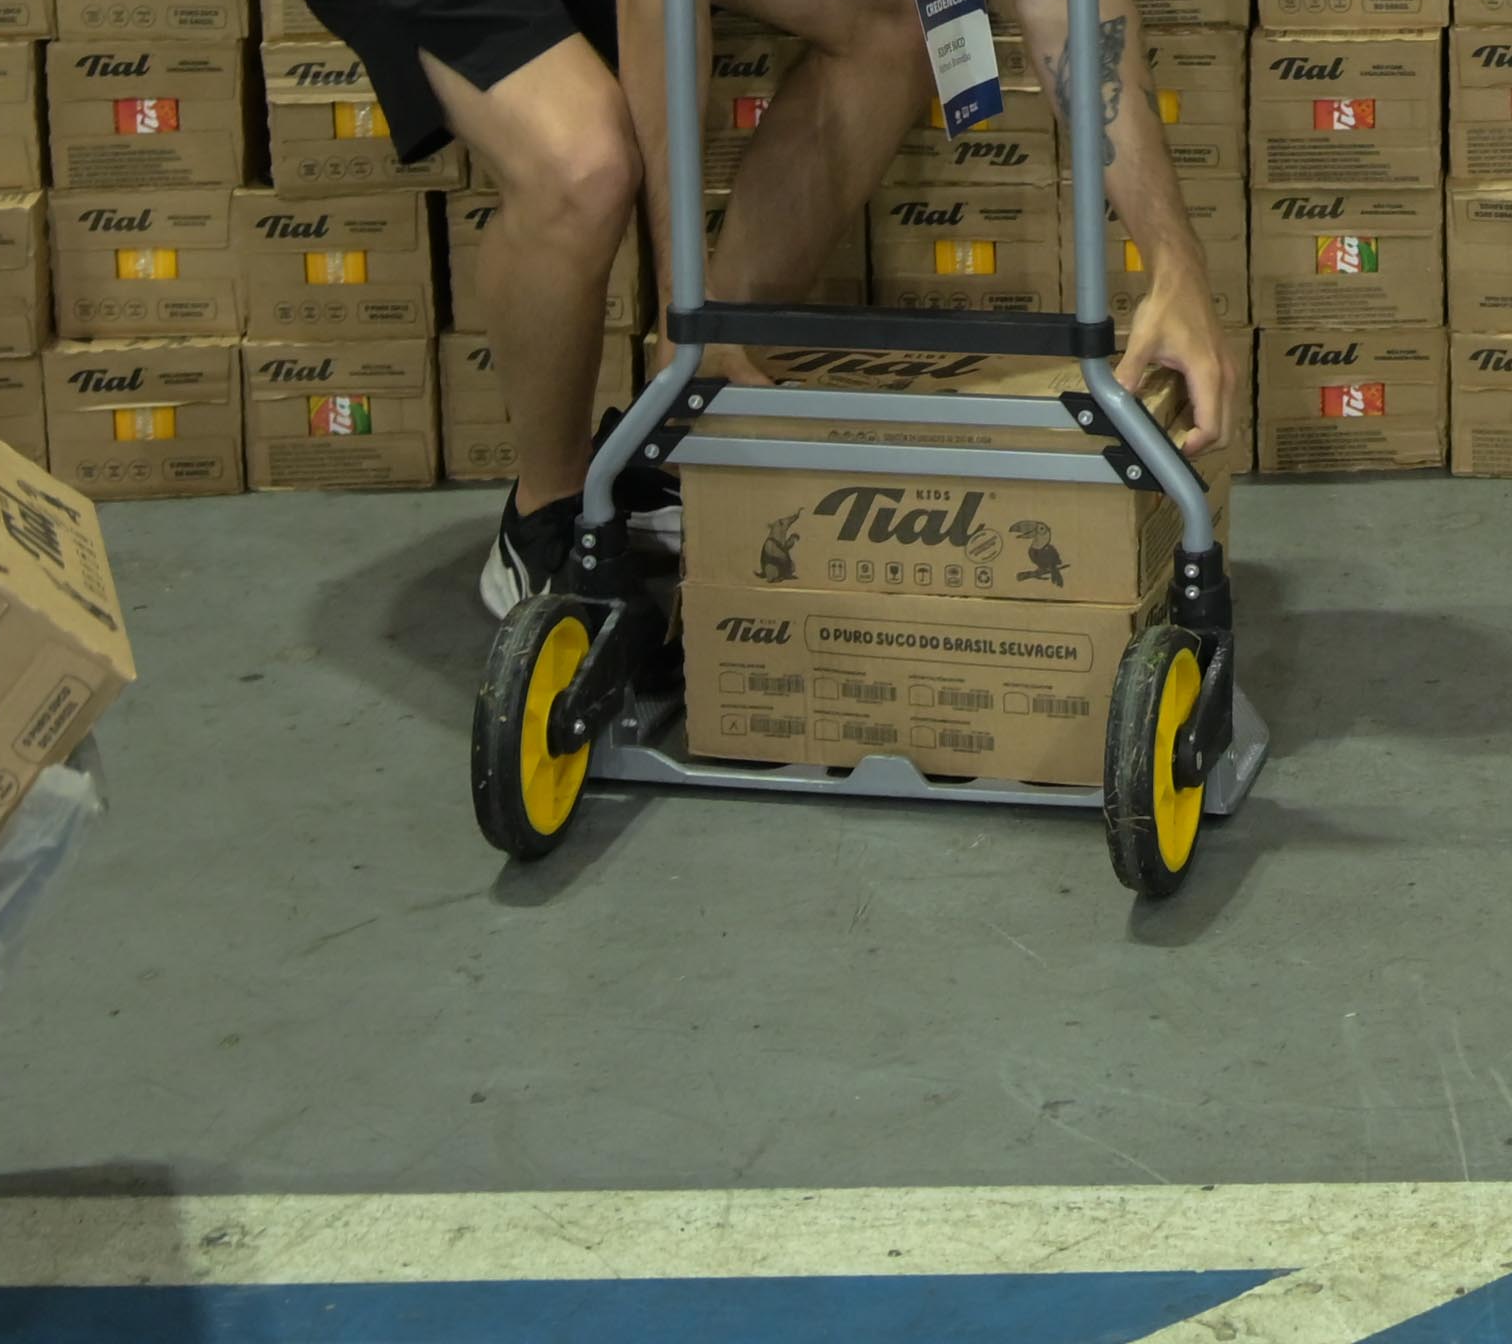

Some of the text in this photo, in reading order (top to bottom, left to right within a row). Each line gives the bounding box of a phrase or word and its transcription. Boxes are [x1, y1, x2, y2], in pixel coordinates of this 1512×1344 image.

[76, 54, 150, 77] Tial
[1270, 57, 1344, 80] Tial
[955, 142, 1029, 166] Tial
[79, 209, 152, 231] Tial
[890, 202, 964, 225] Tial
[256, 215, 329, 238] Tial
[767, 349, 989, 379] Tial
[1286, 343, 1358, 365] Tial
[68, 368, 143, 392] Tial
[259, 358, 333, 382] Tial
[915, 488, 951, 500] KIDS
[812, 486, 985, 548] Tial
[715, 616, 792, 645] Tial
[819, 628, 1078, 661] O PURO SUCO DO BRASIL SELVAGEM
